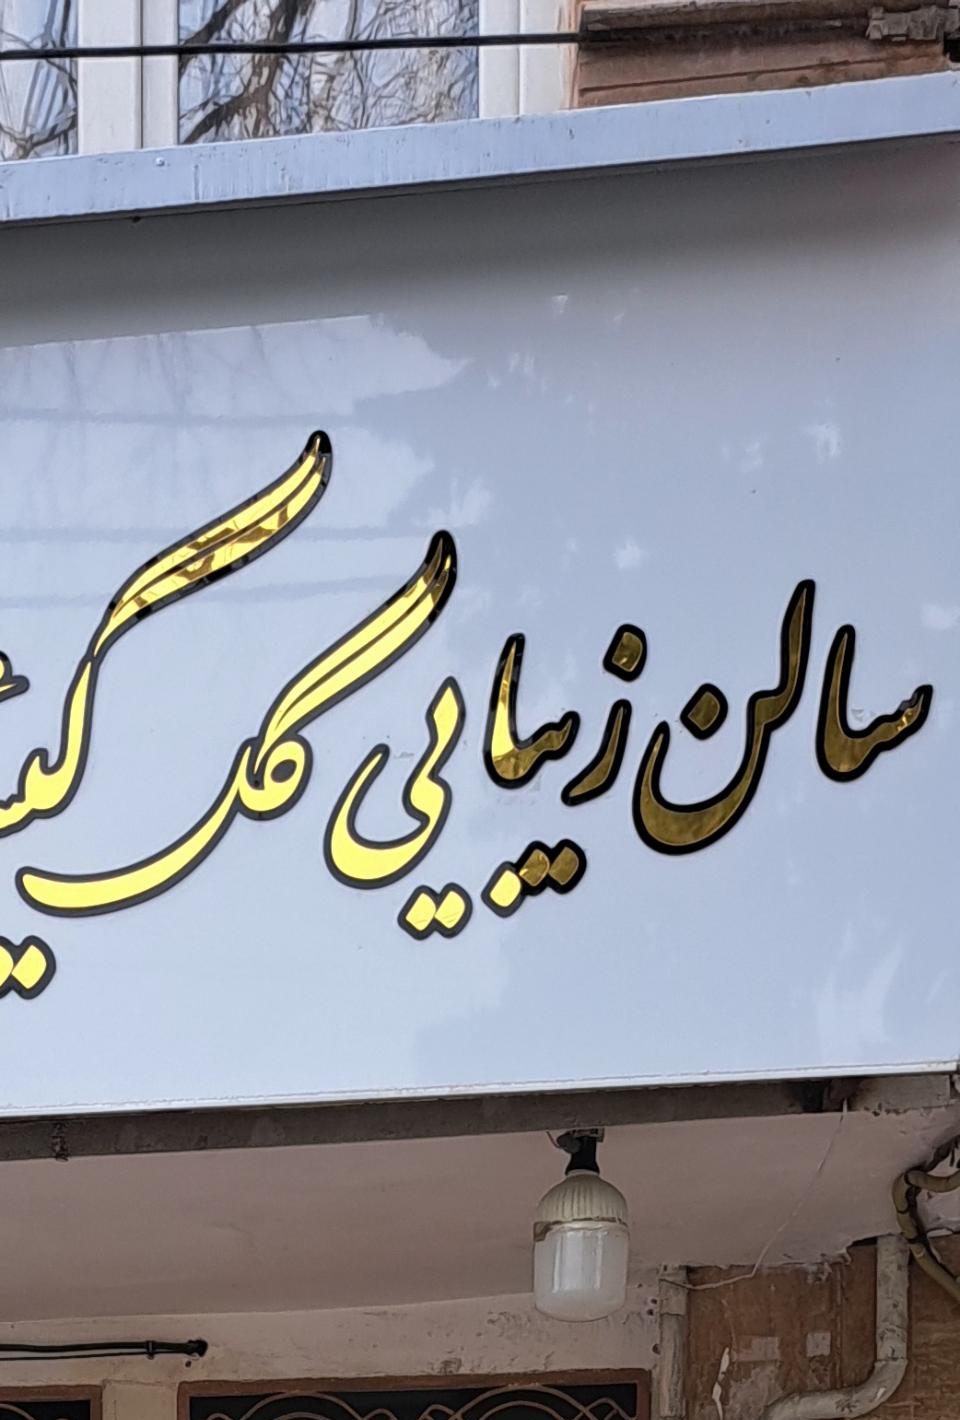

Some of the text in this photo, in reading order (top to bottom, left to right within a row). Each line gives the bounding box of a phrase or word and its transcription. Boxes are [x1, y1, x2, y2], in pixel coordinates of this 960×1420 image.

[15, 530, 457, 917] گل
[323, 624, 647, 940] زیبایی
[633, 579, 933, 855] سالن
